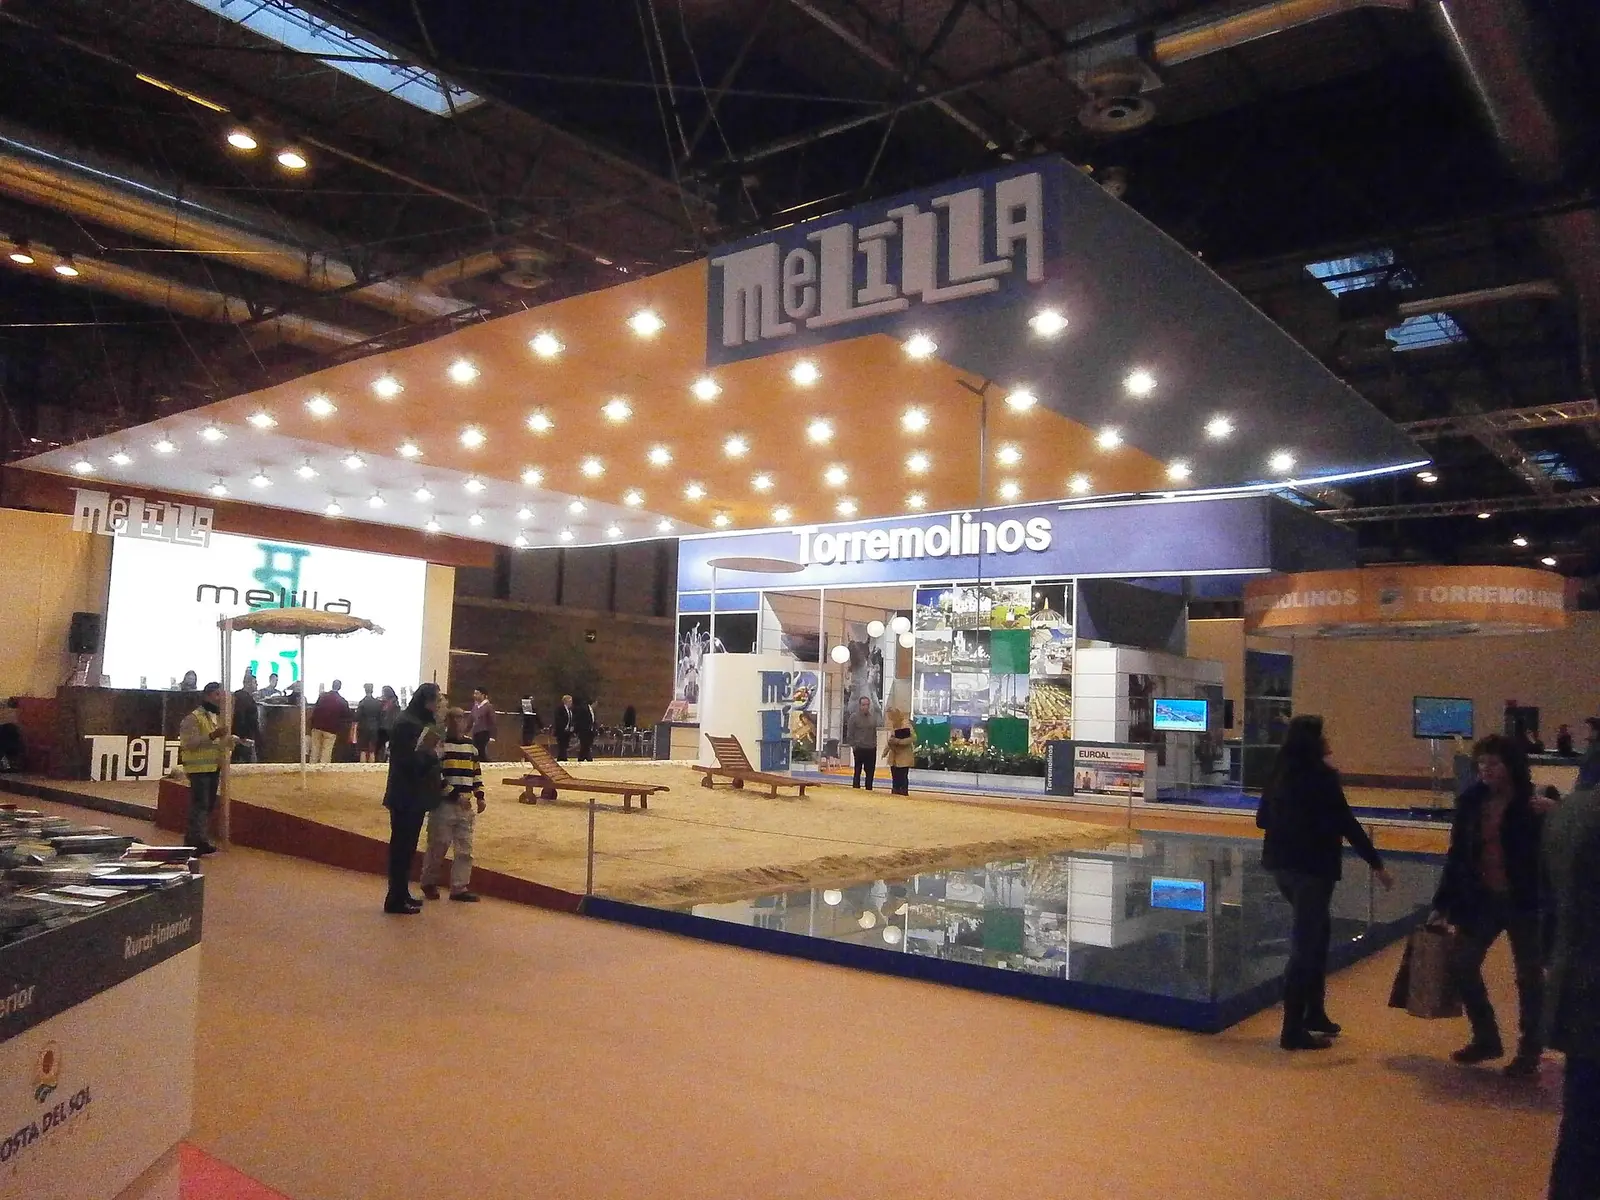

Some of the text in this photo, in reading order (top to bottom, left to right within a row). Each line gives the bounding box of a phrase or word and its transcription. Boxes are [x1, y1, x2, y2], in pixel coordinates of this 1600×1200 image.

[792, 512, 1052, 566] Torremolinos
[196, 583, 352, 615] melilla
[1046, 744, 1054, 791] Torremolinos
[1079, 750, 1111, 759] EUROAL
[43, 1101, 67, 1133] DEL
